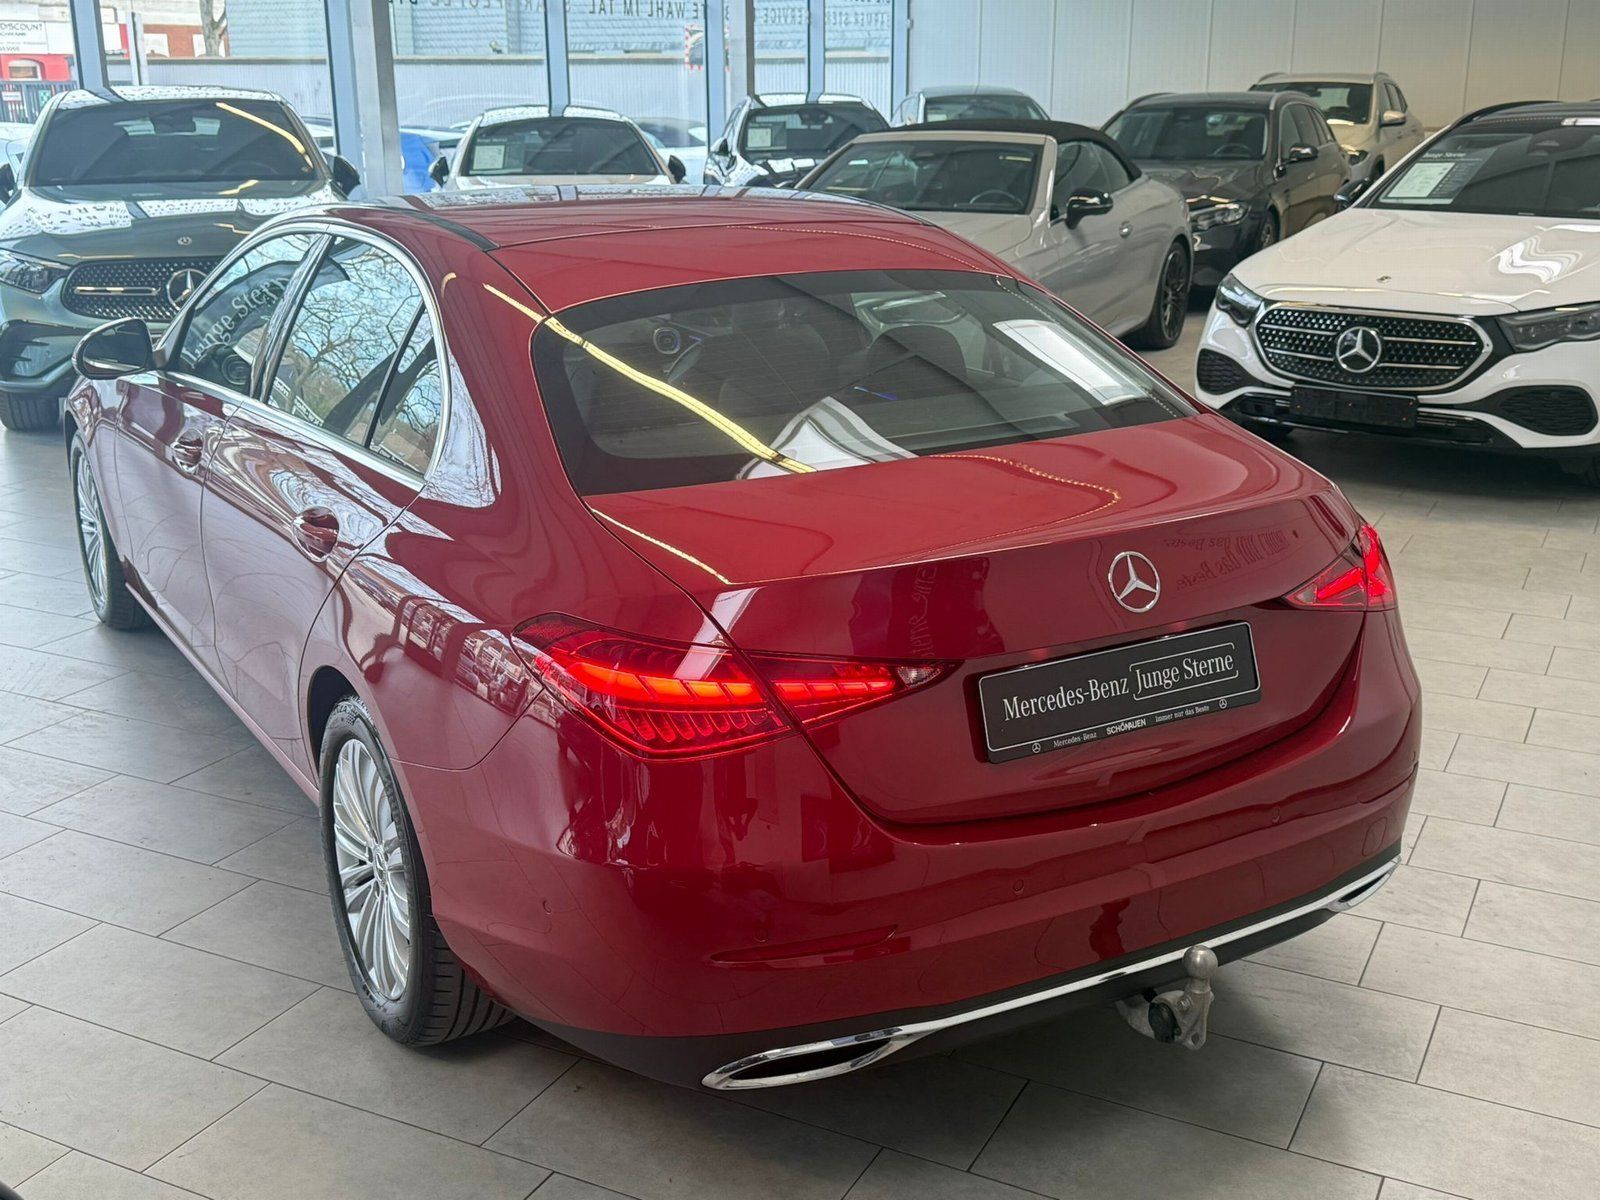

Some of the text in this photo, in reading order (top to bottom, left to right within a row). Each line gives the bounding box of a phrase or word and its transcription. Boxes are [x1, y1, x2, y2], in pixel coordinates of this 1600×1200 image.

[1003, 654, 1234, 721] Mercedes-Benz Junge Sterne
[1053, 731, 1097, 748] Mercedes-Benz
